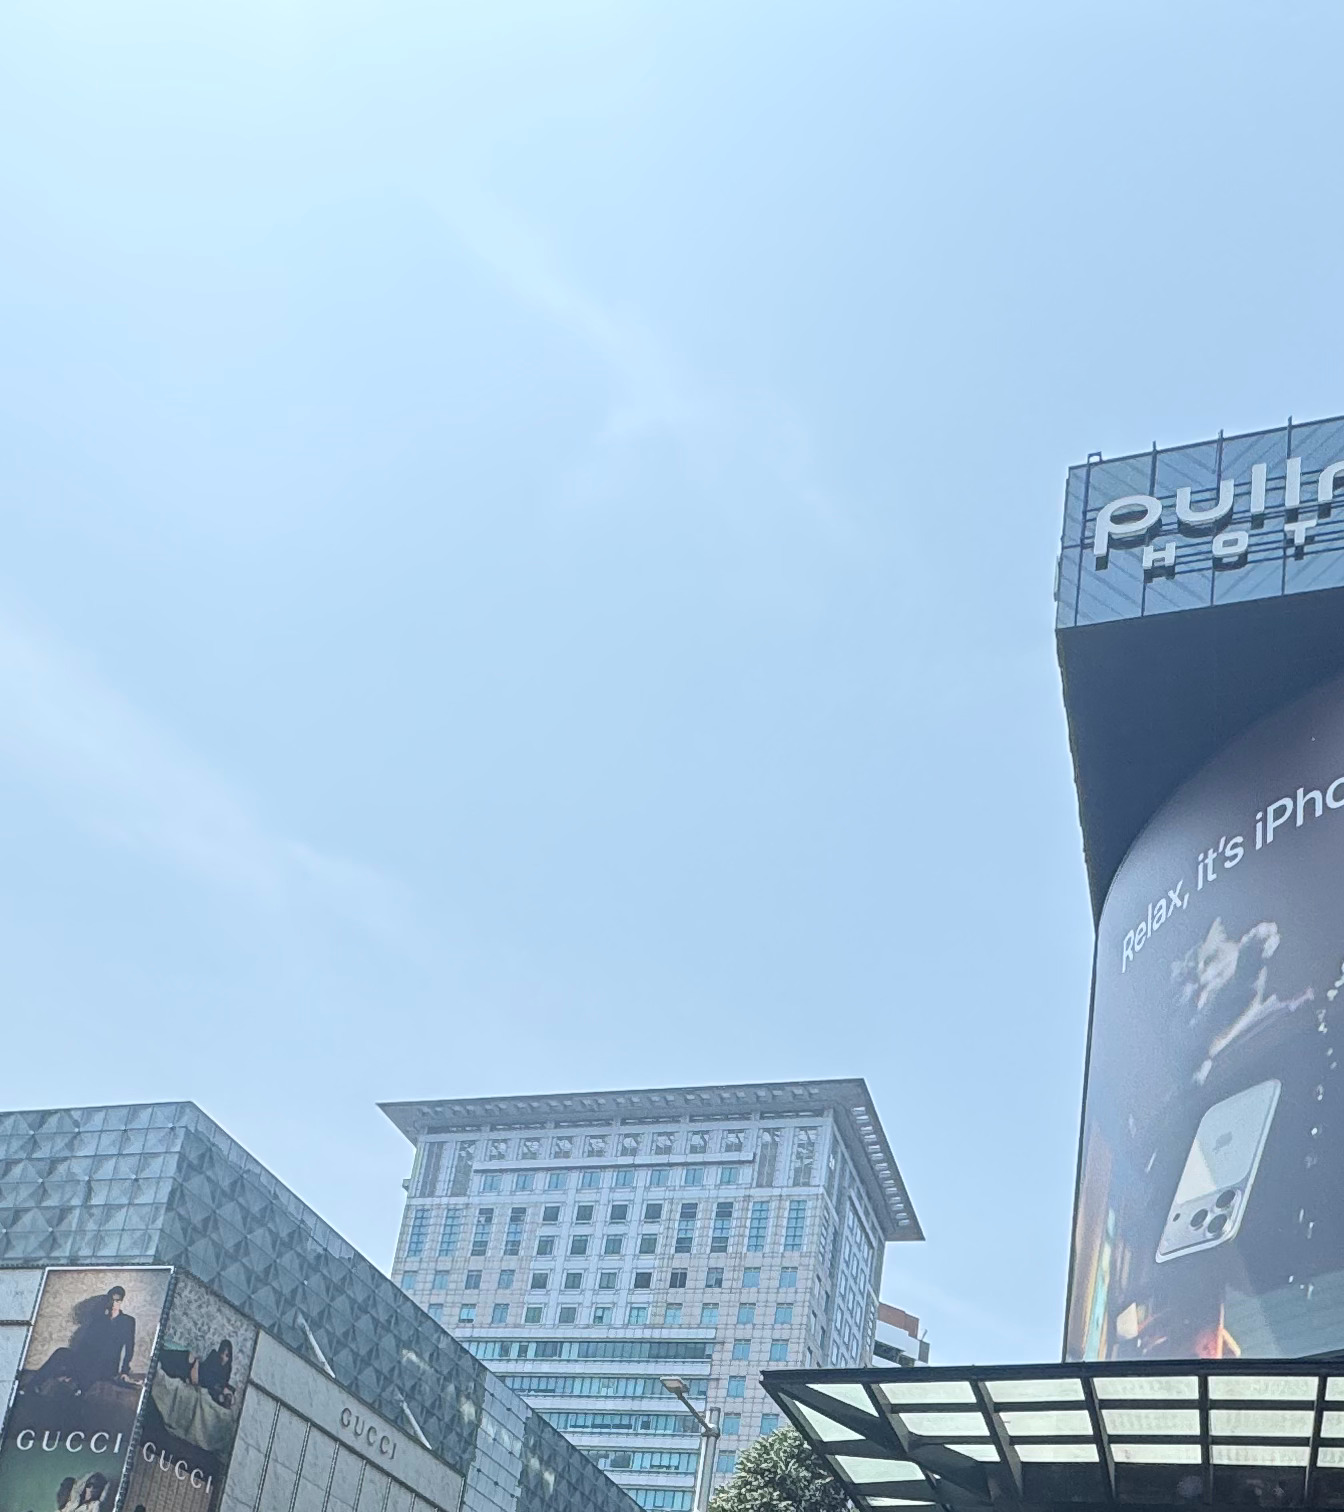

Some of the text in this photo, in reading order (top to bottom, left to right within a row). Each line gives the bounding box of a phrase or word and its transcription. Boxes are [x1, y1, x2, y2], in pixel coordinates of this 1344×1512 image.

[1122, 880, 1189, 973] Relax,
[1197, 836, 1245, 891] it's
[15, 1429, 122, 1453] GUCCI
[340, 1407, 397, 1460] GUCCI
[142, 1442, 212, 1494] GUCCI
